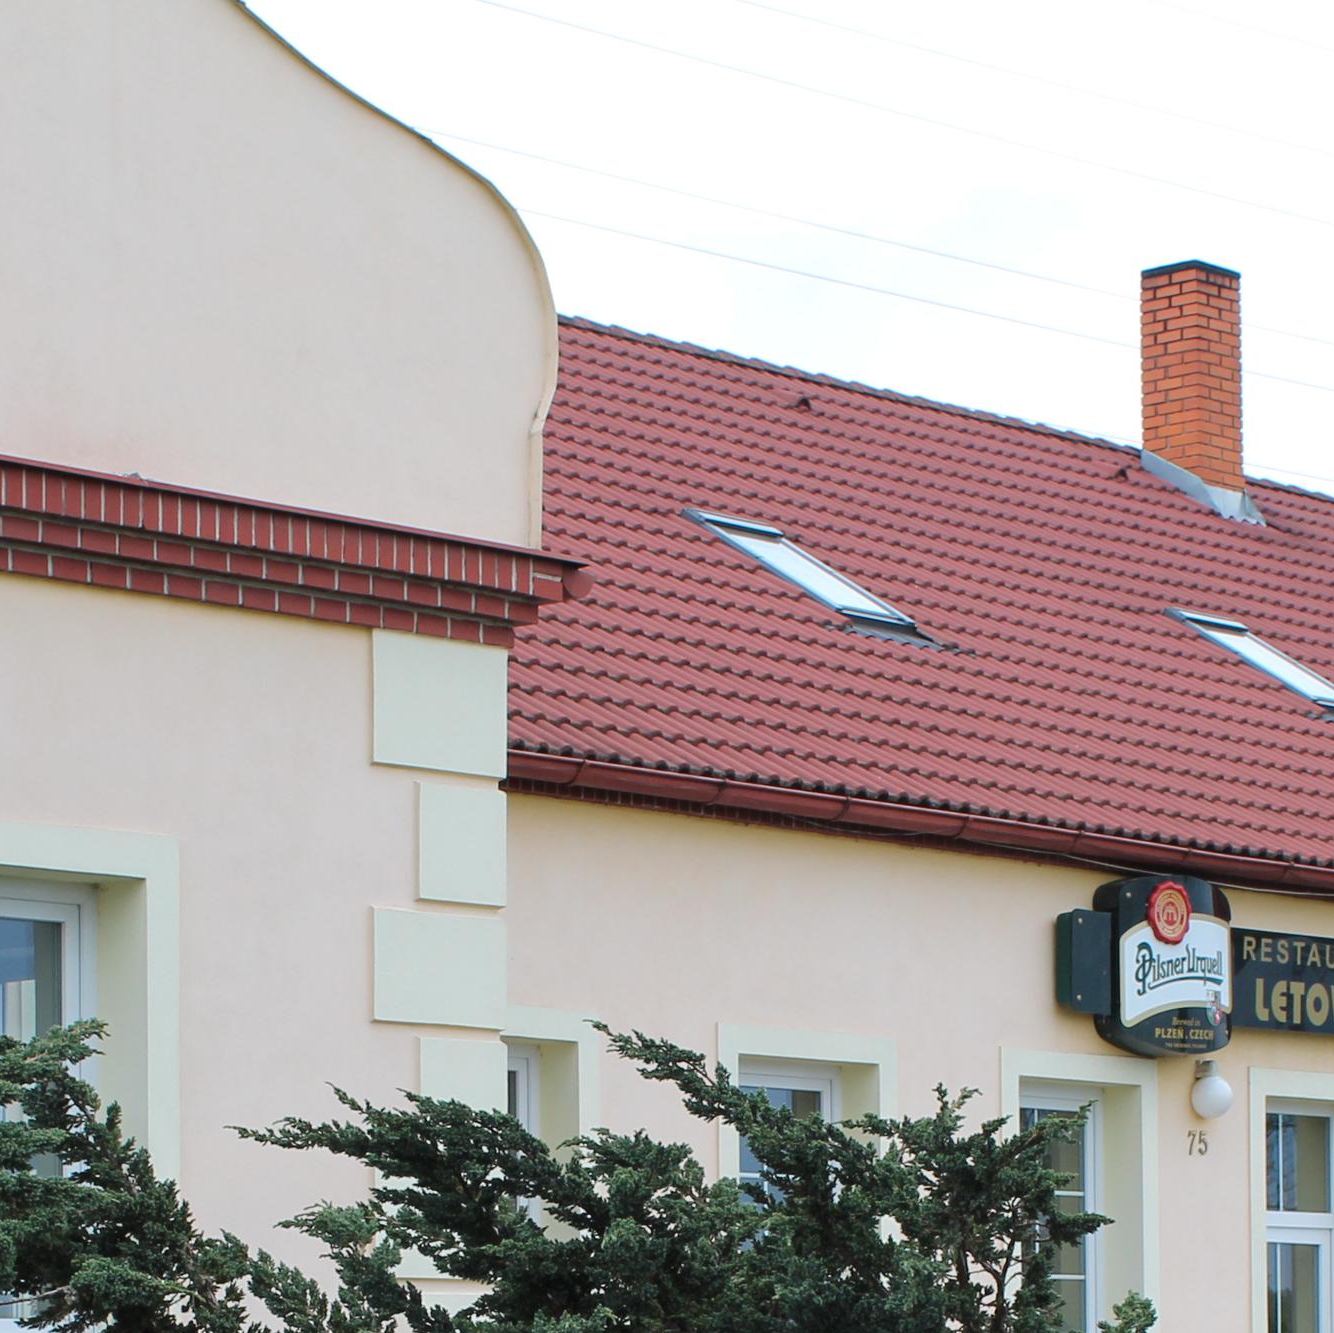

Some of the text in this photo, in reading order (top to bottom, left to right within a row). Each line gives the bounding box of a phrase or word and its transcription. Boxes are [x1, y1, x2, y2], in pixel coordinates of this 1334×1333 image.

[1135, 941, 1223, 996] Pilsner Urquell
[1189, 1029, 1214, 1040] CZECH
[1187, 1130, 1208, 1156] 75
